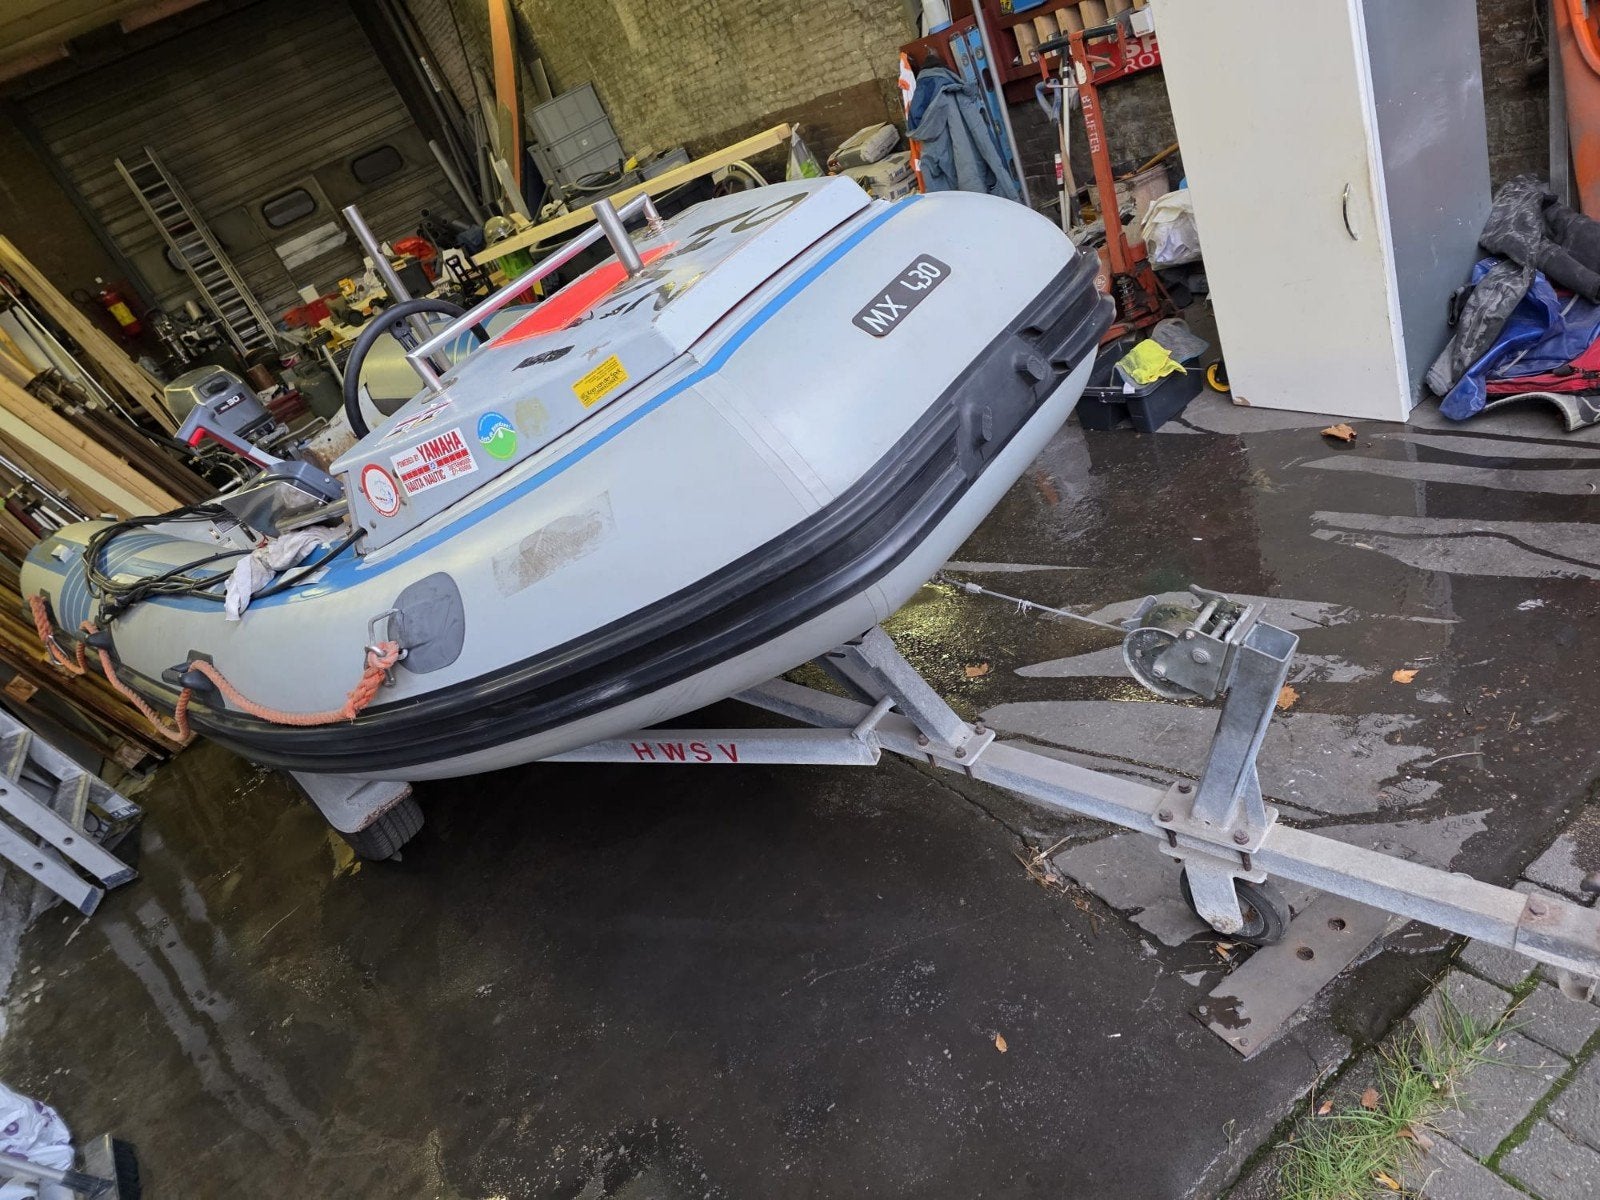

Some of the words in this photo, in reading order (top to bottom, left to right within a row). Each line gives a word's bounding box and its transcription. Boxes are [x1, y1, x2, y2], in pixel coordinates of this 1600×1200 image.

[1124, 49, 1160, 73] RO
[1081, 95, 1093, 110] BT
[1084, 113, 1100, 154] LIFTER
[862, 294, 908, 333] MX
[900, 261, 941, 291] 430
[226, 395, 240, 406] 30
[413, 454, 420, 462] BY
[416, 431, 463, 462] YAMAHA
[396, 456, 414, 469] POWERED
[404, 478, 426, 494] NAUTA
[423, 469, 447, 486] NAUTIC
[630, 741, 739, 763] HWSV
